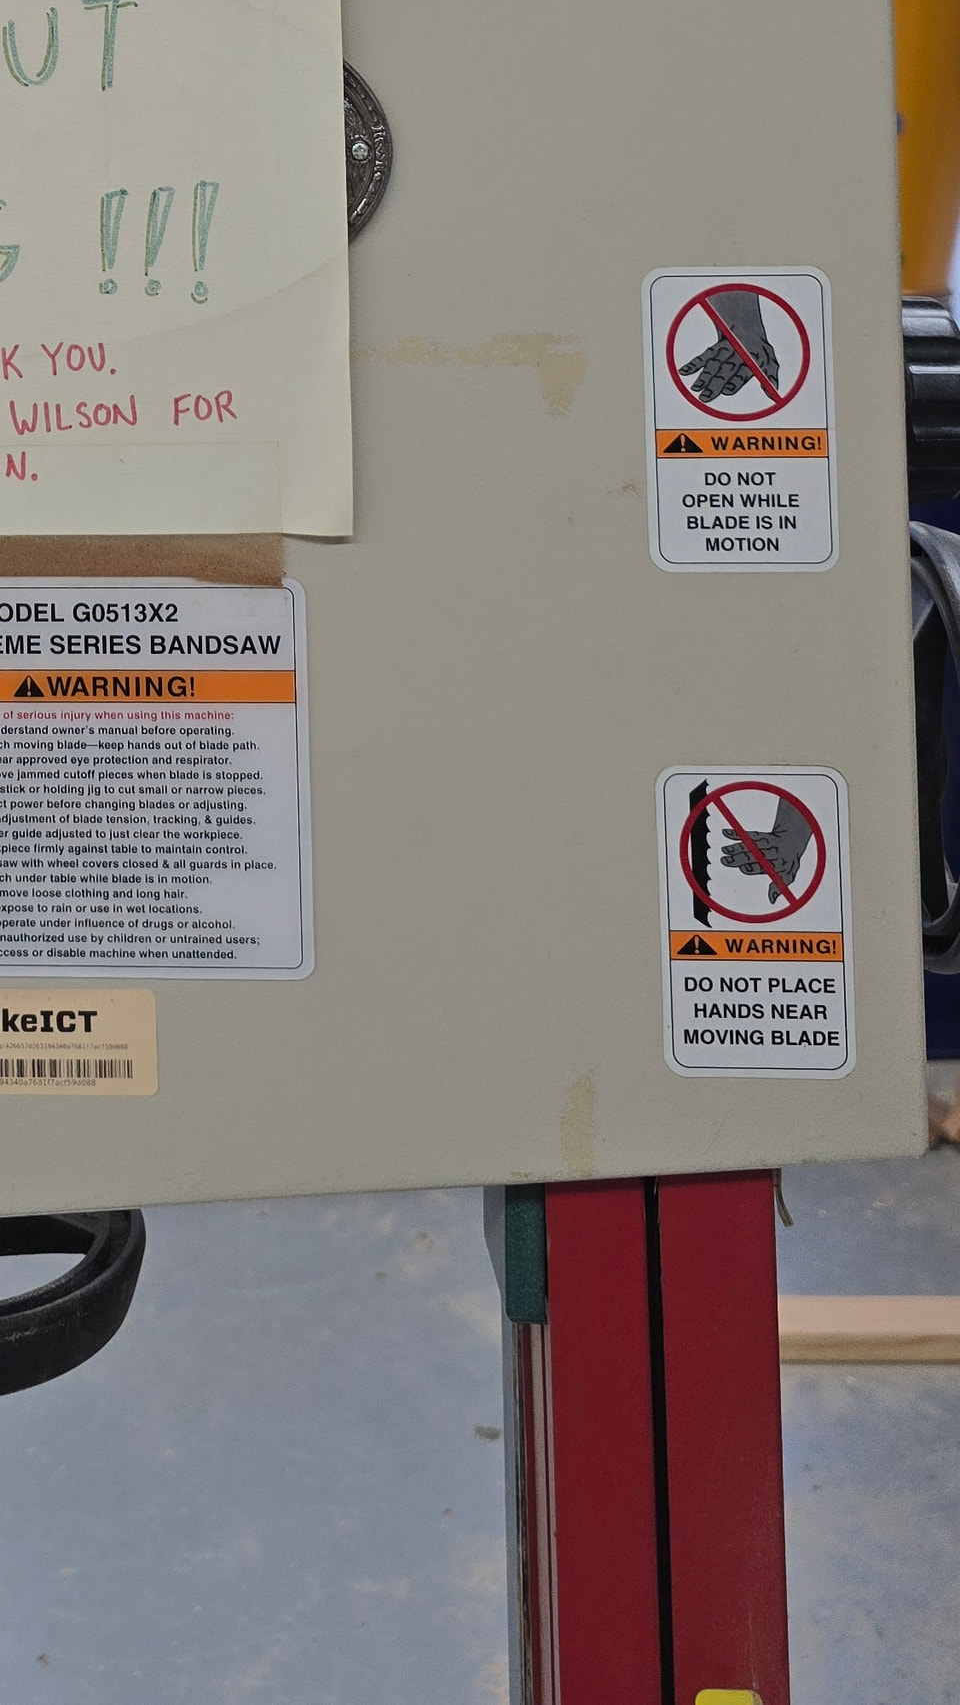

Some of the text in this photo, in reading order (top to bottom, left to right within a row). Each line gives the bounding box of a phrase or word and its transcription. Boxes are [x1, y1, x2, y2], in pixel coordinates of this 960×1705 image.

[100, 180, 220, 304] !!!
[40, 341, 119, 377] YOU.
[9, 394, 138, 437] WILSON
[173, 389, 239, 427] FOR
[711, 437, 820, 450] WARNING!
[705, 472, 776, 486] DO NOT
[682, 494, 799, 507] OPEN WHILE
[687, 516, 796, 529] BLADE IS IN
[706, 537, 778, 551] MOTION
[73, 603, 178, 622] G0513X2
[50, 635, 141, 654] SERIES
[151, 635, 280, 654] BANDSAW
[48, 677, 194, 697] WARNING!
[3, 711, 13, 719] of
[17, 711, 56, 719] serious
[61, 711, 90, 721] injury
[95, 711, 123, 719] when
[128, 711, 157, 721] using
[161, 711, 180, 719] this
[185, 711, 233, 719] machine:
[52, 726, 94, 734] owner's
[98, 726, 137, 735] manual
[142, 726, 176, 735] before
[180, 726, 234, 737] operating.
[32, 888, 61, 897] loose
[65, 889, 109, 900] clothing
[113, 889, 132, 898] and
[137, 889, 160, 901] long
[164, 889, 187, 898] hair.
[725, 939, 836, 954] WARNING!
[685, 977, 836, 993] DO NOT PLACE
[694, 1003, 827, 1019] HANDS NEAR
[684, 1029, 840, 1046] MOVING BLADE
